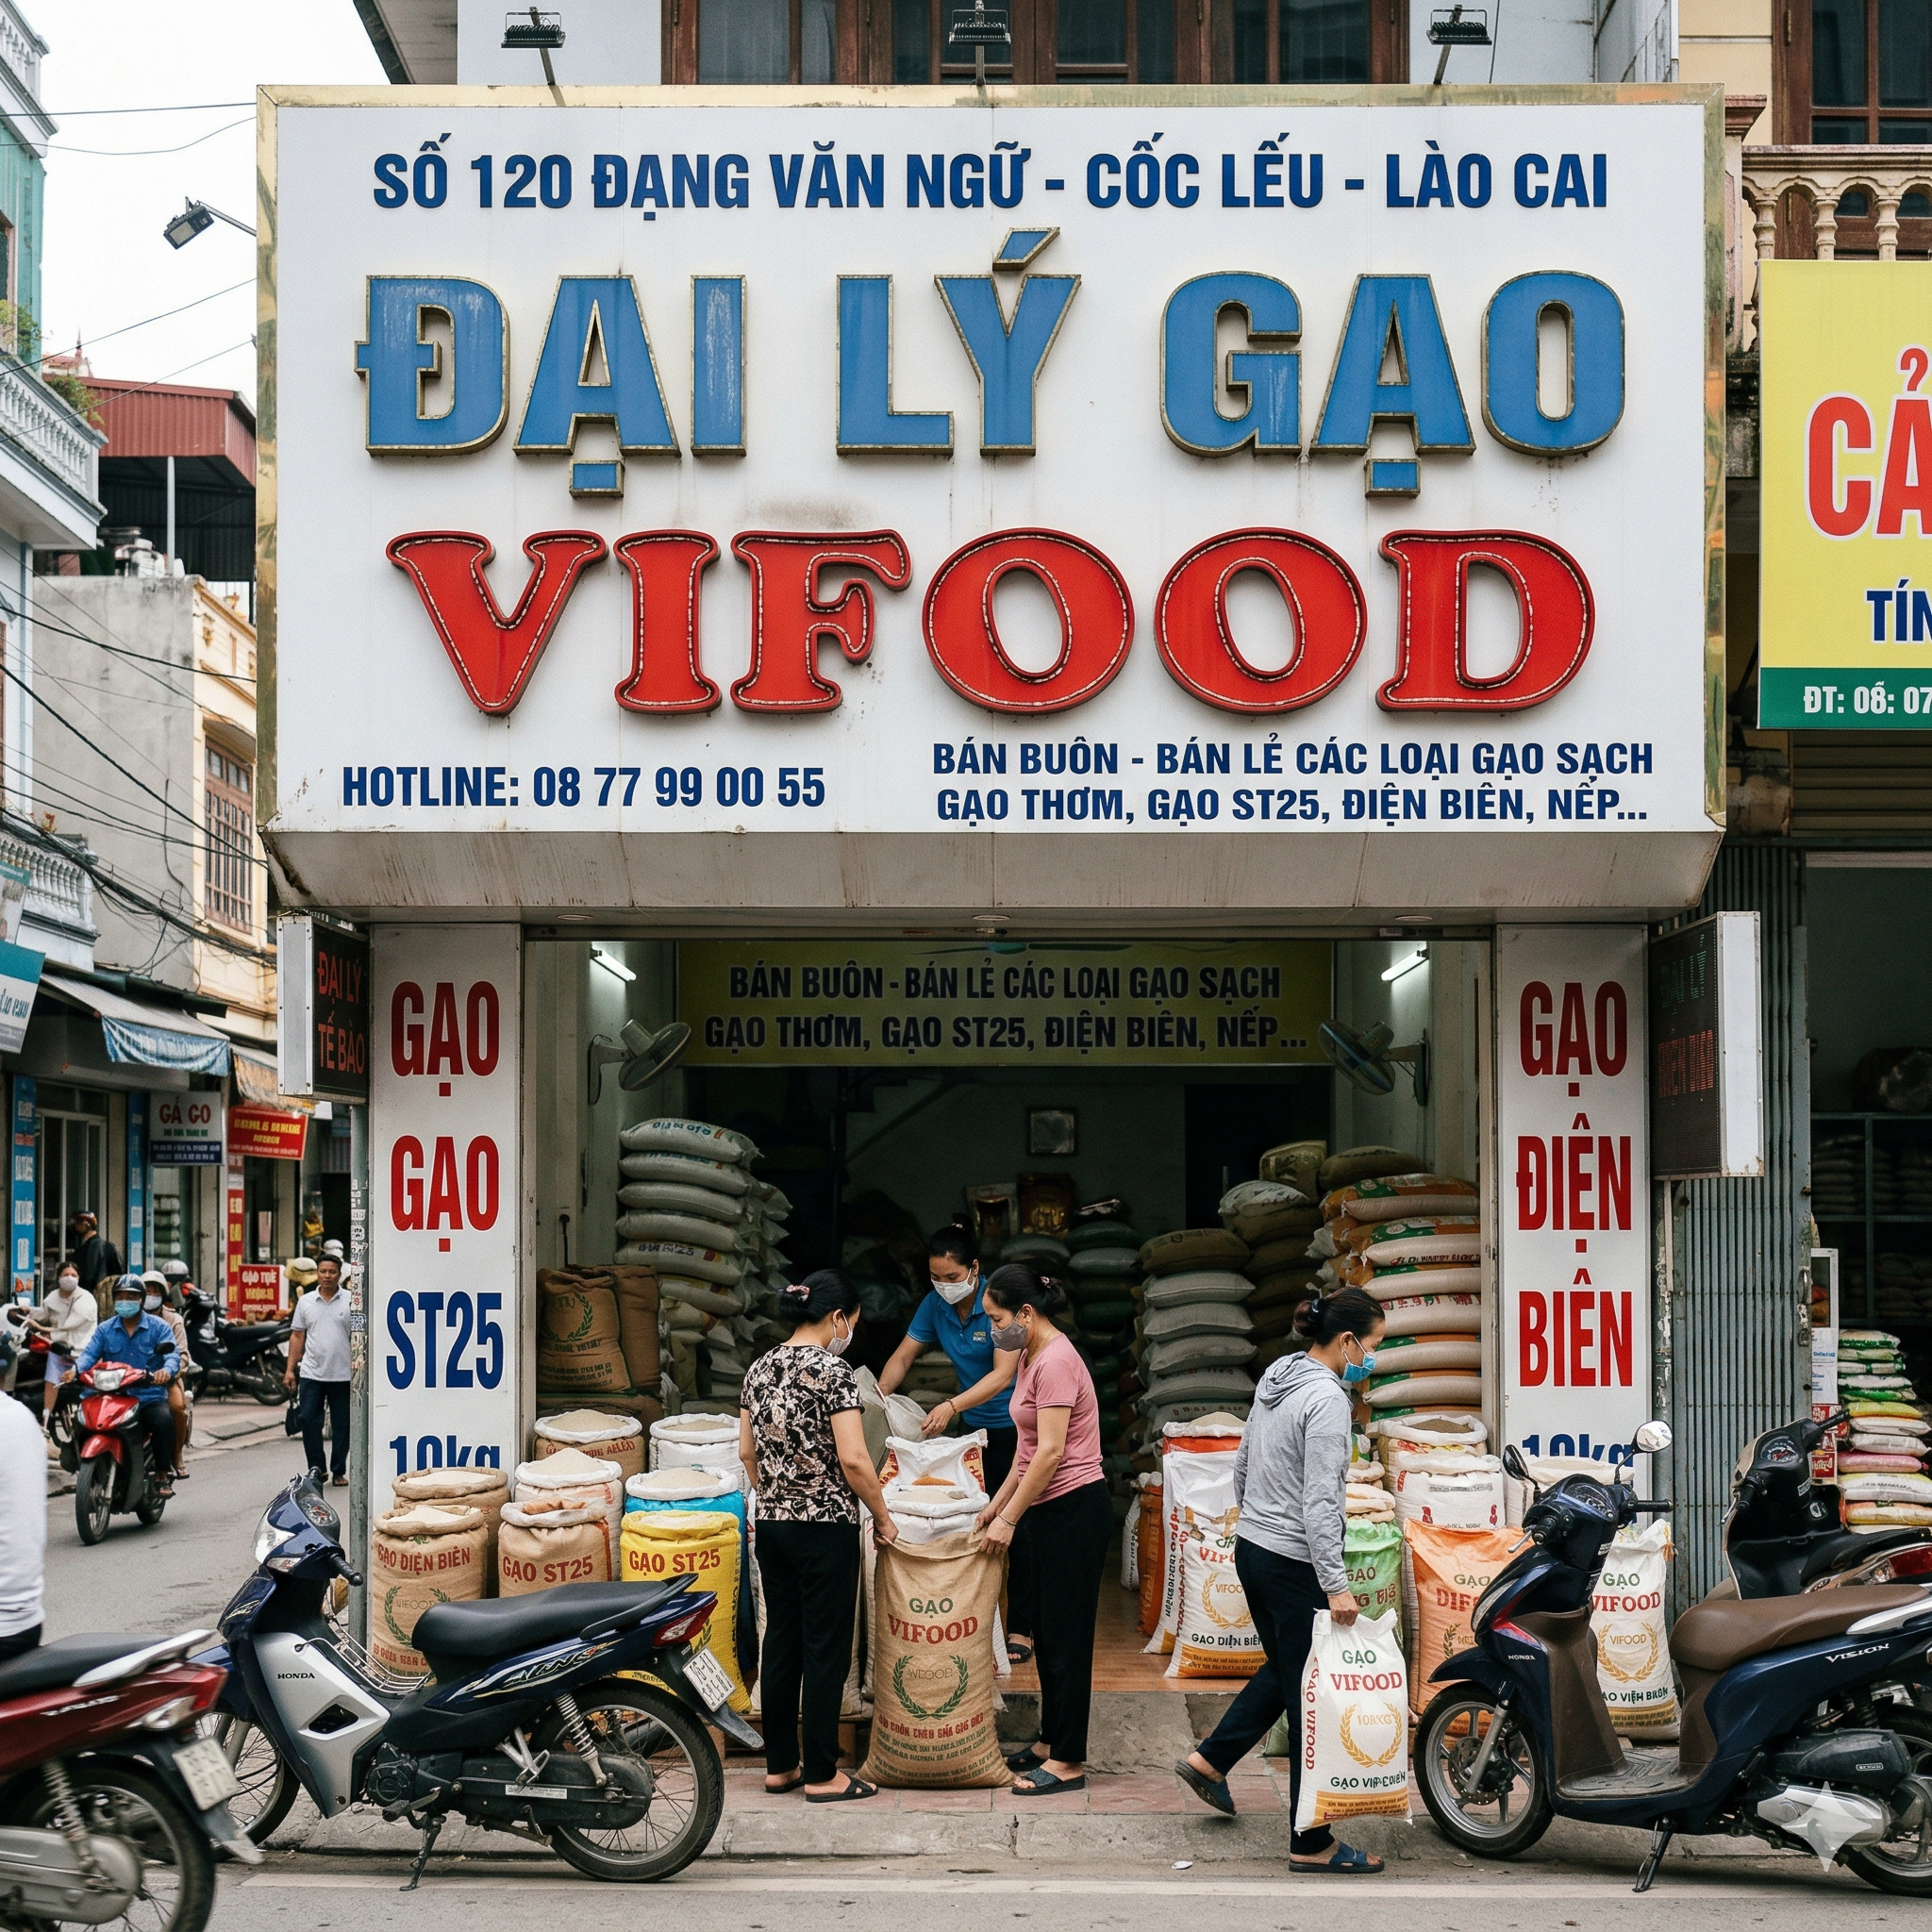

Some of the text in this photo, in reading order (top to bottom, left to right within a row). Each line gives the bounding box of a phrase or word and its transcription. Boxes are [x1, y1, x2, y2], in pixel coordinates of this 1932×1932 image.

[374, 133, 451, 208] SỐ
[472, 154, 572, 208] 120
[591, 154, 749, 221] ĐẠNG
[769, 141, 884, 208] VĂN
[907, 142, 1030, 208] NGỮ
[1087, 132, 1199, 208] CỐC
[1222, 132, 1324, 208] LẾU
[1387, 140, 1492, 208] LÀO
[1514, 152, 1607, 208] CAI
[354, 226, 1625, 499] ĐẠI LÝ GẠO
[386, 527, 1595, 716] VIFOOD
[1804, 686, 1844, 713] ĐT:
[933, 736, 1007, 774] BÁN
[1020, 736, 1118, 774] BUÔN
[1157, 736, 1230, 774] BÁN
[1243, 732, 1283, 774] LẺ
[1296, 736, 1368, 774] CÁC
[1380, 742, 1459, 781] LOẠI
[1472, 742, 1544, 781] GẠO
[1557, 742, 1653, 782] SẠCH
[342, 766, 825, 808] HOTLINE: 08 77 99 00 55
[937, 789, 1008, 827] GẠO
[1021, 787, 1135, 825] THƠM,
[1147, 789, 1220, 827] GẠO
[1232, 789, 1330, 824] ST25,
[1341, 781, 1426, 827] ĐIỆN
[1440, 781, 1535, 824] BIÊN,
[317, 951, 361, 1005] ĐẠI LÝ
[729, 959, 791, 999] BÁN
[802, 959, 884, 999] BUÔN
[905, 960, 958, 999] BÁN
[966, 957, 994, 999] LẺ
[1004, 960, 1055, 999] CÁC
[1063, 966, 1120, 1006] LOẠI
[1130, 966, 1189, 1006] GẠO
[1199, 966, 1280, 1006] SẠCH
[318, 1010, 365, 1074] TẾ BÀO
[391, 981, 500, 1097] GẠO
[705, 1016, 766, 1055] GẠO
[775, 1013, 871, 1052] THƠM,
[881, 1016, 942, 1055] GẠO
[952, 1016, 1035, 1051] ST25,
[1044, 1009, 1116, 1055] ĐIỆN
[1126, 1009, 1206, 1051] BIÊN,
[1520, 980, 1627, 1097] GẠO
[391, 1135, 500, 1252] GẠO
[1516, 1112, 1632, 1254] ĐIỆN
[386, 1291, 503, 1391] ST25
[1519, 1268, 1633, 1388] BIÊN
[503, 1555, 593, 1583] GẠO ST25
[629, 1548, 721, 1575] GẠO ST25
[1454, 1574, 1491, 1589] GẠO
[1603, 1573, 1641, 1590] GẠO
[908, 1598, 953, 1619] GẠO
[1216, 1584, 1244, 1593] VIFOO
[1592, 1591, 1660, 1611] VIFOOD
[888, 1613, 978, 1644] VIFOOD
[1610, 1634, 1646, 1644] VIFOOD
[1341, 1650, 1376, 1668] GẠO
[1825, 1643, 1890, 1663] VISION
[1330, 1672, 1403, 1691] VIFOOD
[1601, 1691, 1617, 1701] AO
[1306, 1709, 1315, 1770] VIFOOD
[1331, 1777, 1358, 1790] GẠO
